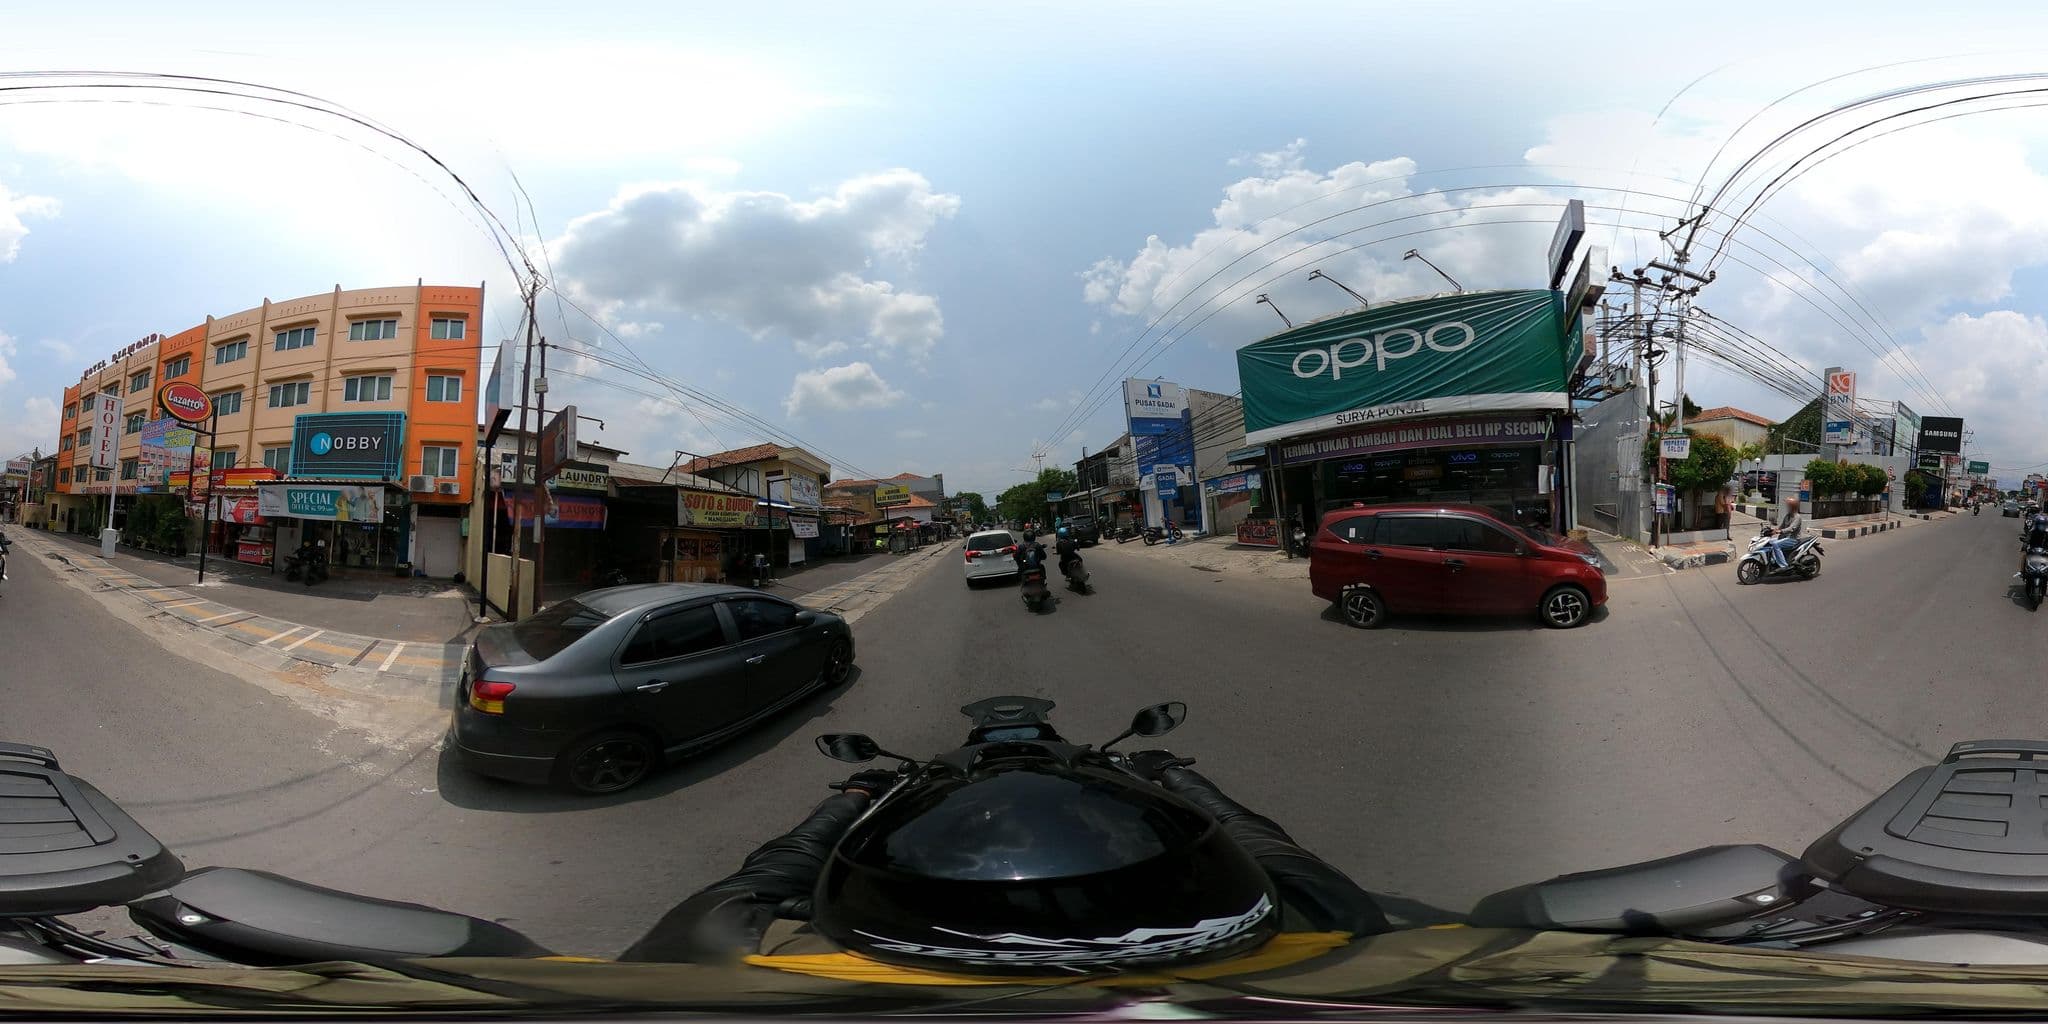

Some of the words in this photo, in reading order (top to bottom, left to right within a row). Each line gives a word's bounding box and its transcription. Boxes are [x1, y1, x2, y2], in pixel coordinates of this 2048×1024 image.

[112, 333, 157, 362] DIAMOND
[1292, 321, 1475, 380] oppo
[1830, 395, 1848, 404] BNI
[1336, 409, 1375, 424] SURYA
[100, 399, 115, 466] HOTEL
[1924, 429, 1958, 438] SAMSUNG
[320, 437, 381, 450] NOBBY
[1283, 444, 1315, 459] TERIMA
[1318, 437, 1350, 453] TUKAR
[1351, 431, 1396, 450] TAMBAH
[1399, 428, 1426, 442] DAN
[1426, 425, 1454, 440] JUAL
[1455, 423, 1482, 437] BELI
[1484, 423, 1502, 436] HP
[559, 472, 608, 483] LAUNDRY
[291, 492, 331, 505] SPECIAL
[684, 494, 714, 510] SOTO
[717, 499, 723, 511] &
